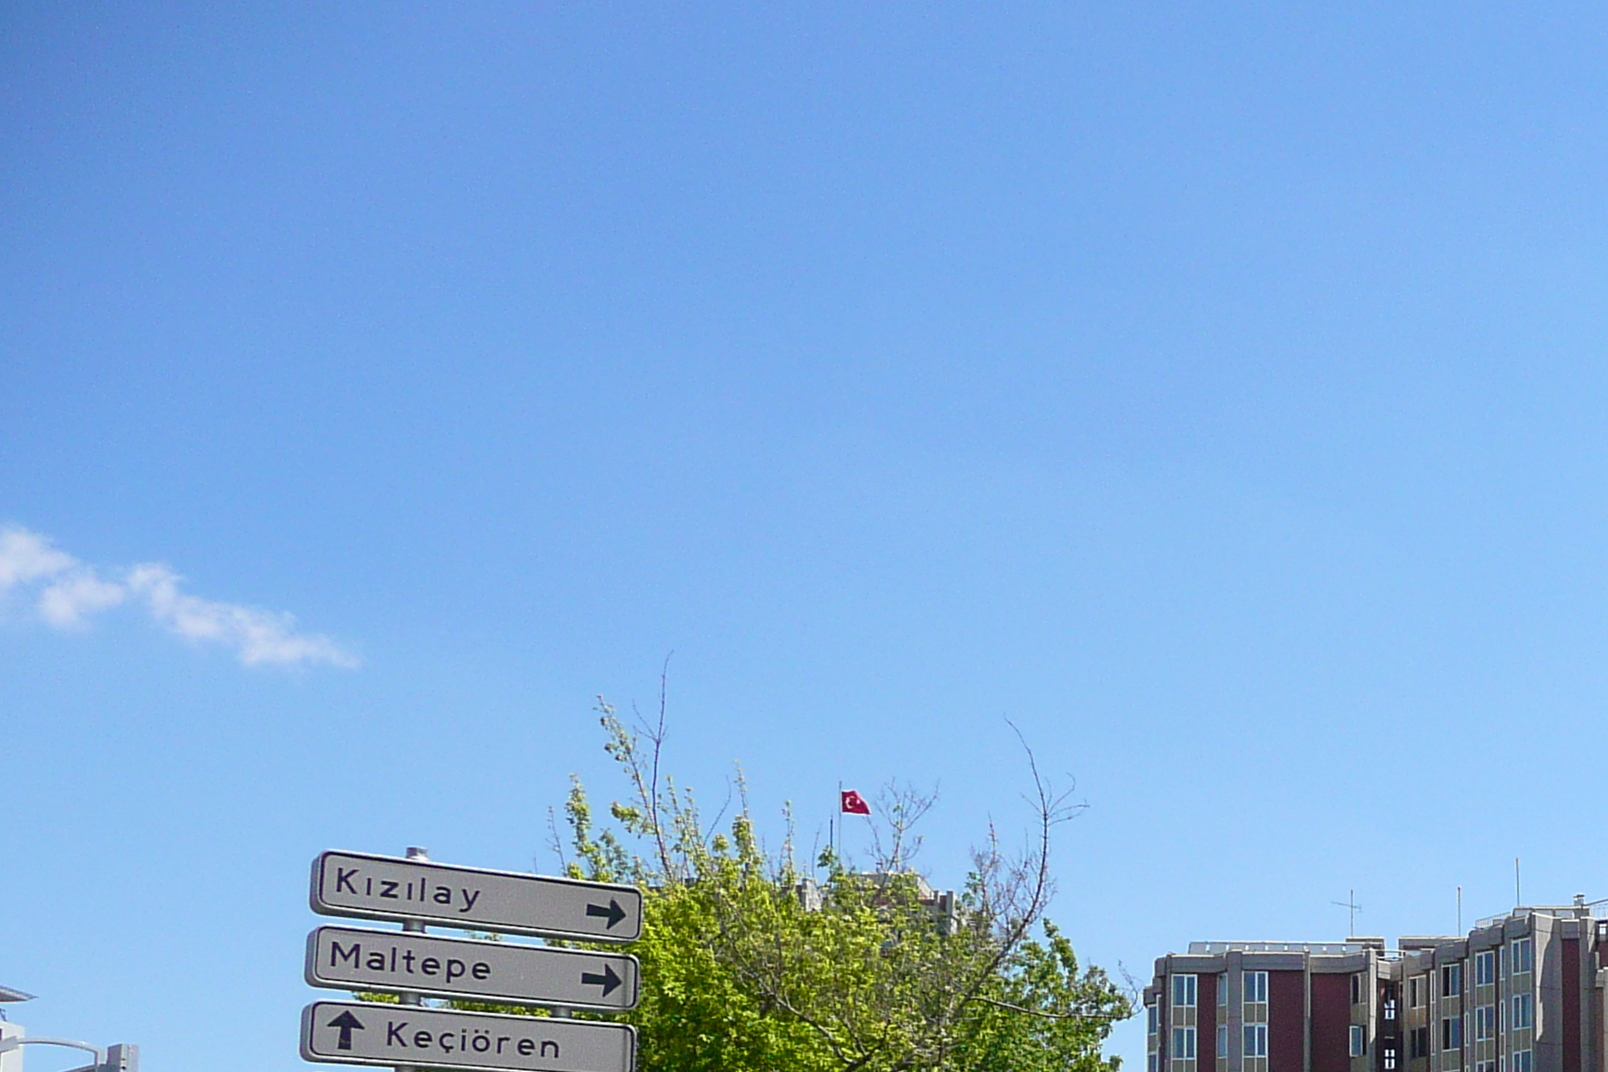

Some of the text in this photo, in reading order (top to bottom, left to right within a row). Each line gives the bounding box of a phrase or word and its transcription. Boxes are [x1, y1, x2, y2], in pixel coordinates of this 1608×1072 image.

[335, 867, 481, 913] Kızılay
[329, 941, 491, 983] Maltepe
[386, 1021, 560, 1058] Keçiören
